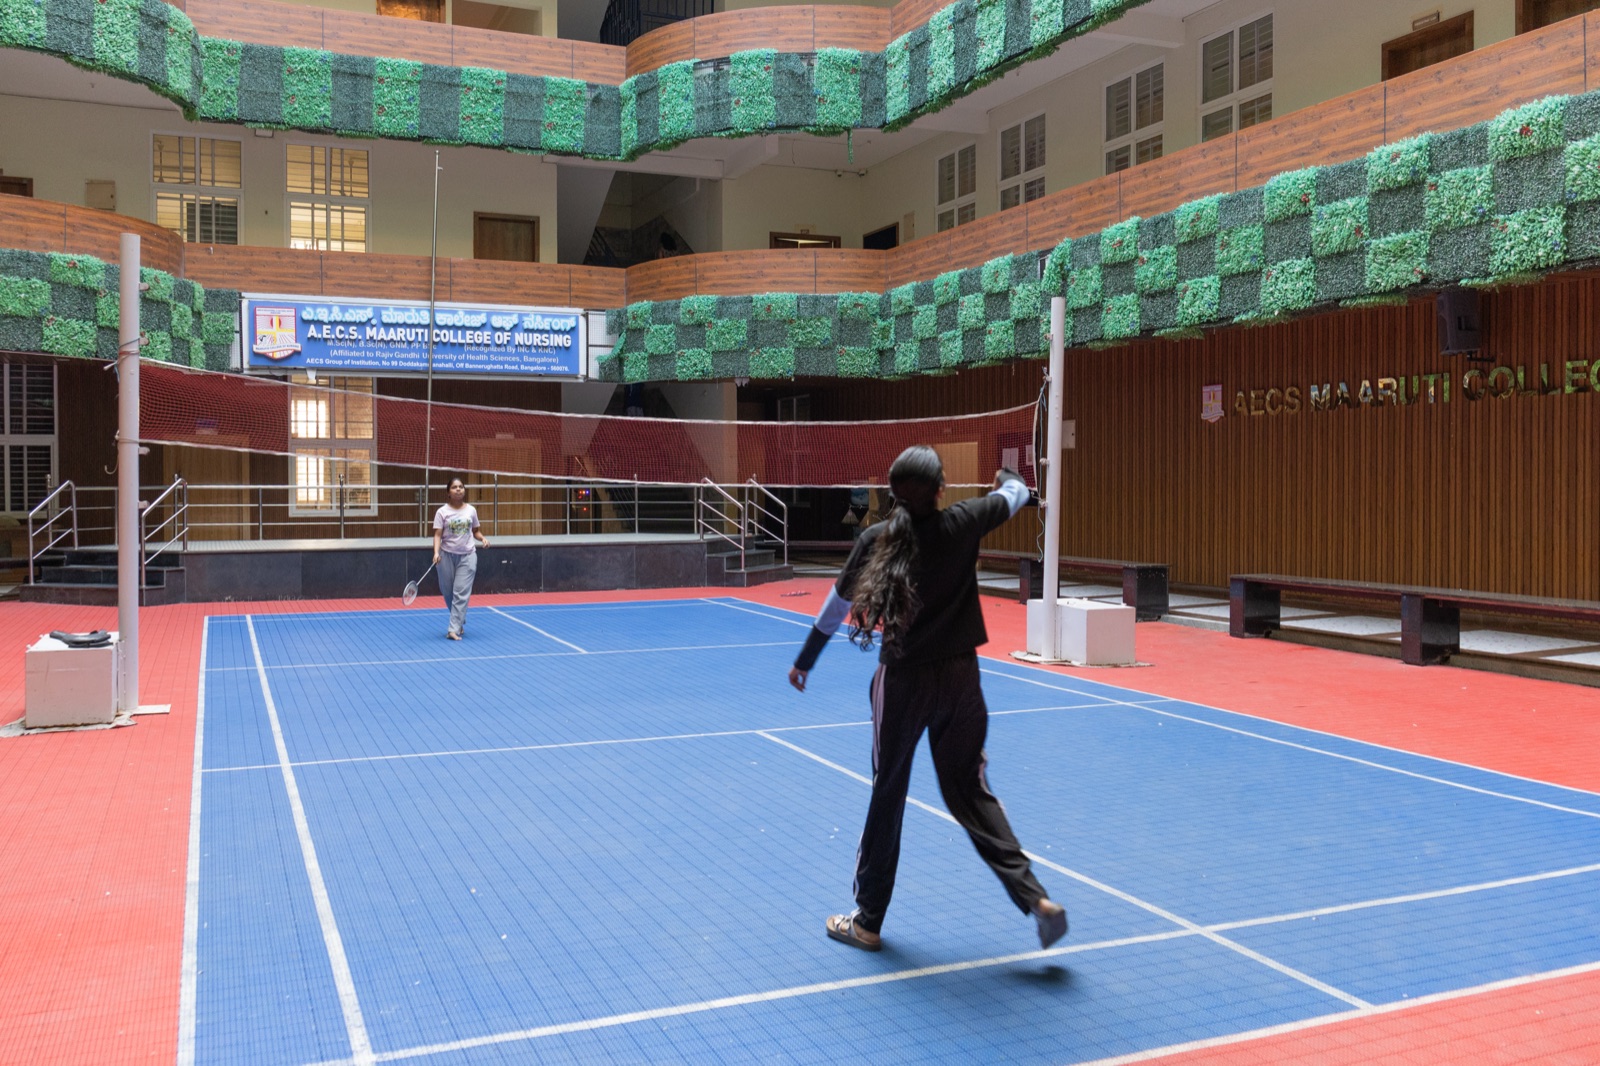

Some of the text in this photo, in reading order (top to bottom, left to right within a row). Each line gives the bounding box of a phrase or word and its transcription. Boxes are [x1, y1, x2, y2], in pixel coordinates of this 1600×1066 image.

[307, 324, 572, 347] A.E.C.S. MAARUTI COLLEGE OF NURSING
[330, 349, 365, 358] (Affiliated
[376, 350, 393, 360] Rajiv
[394, 351, 420, 359] Gandhi
[523, 355, 559, 365] Bangalore)
[507, 345, 515, 354] By
[1233, 386, 1302, 416] AECS
[1310, 372, 1450, 412] MAARUTI
